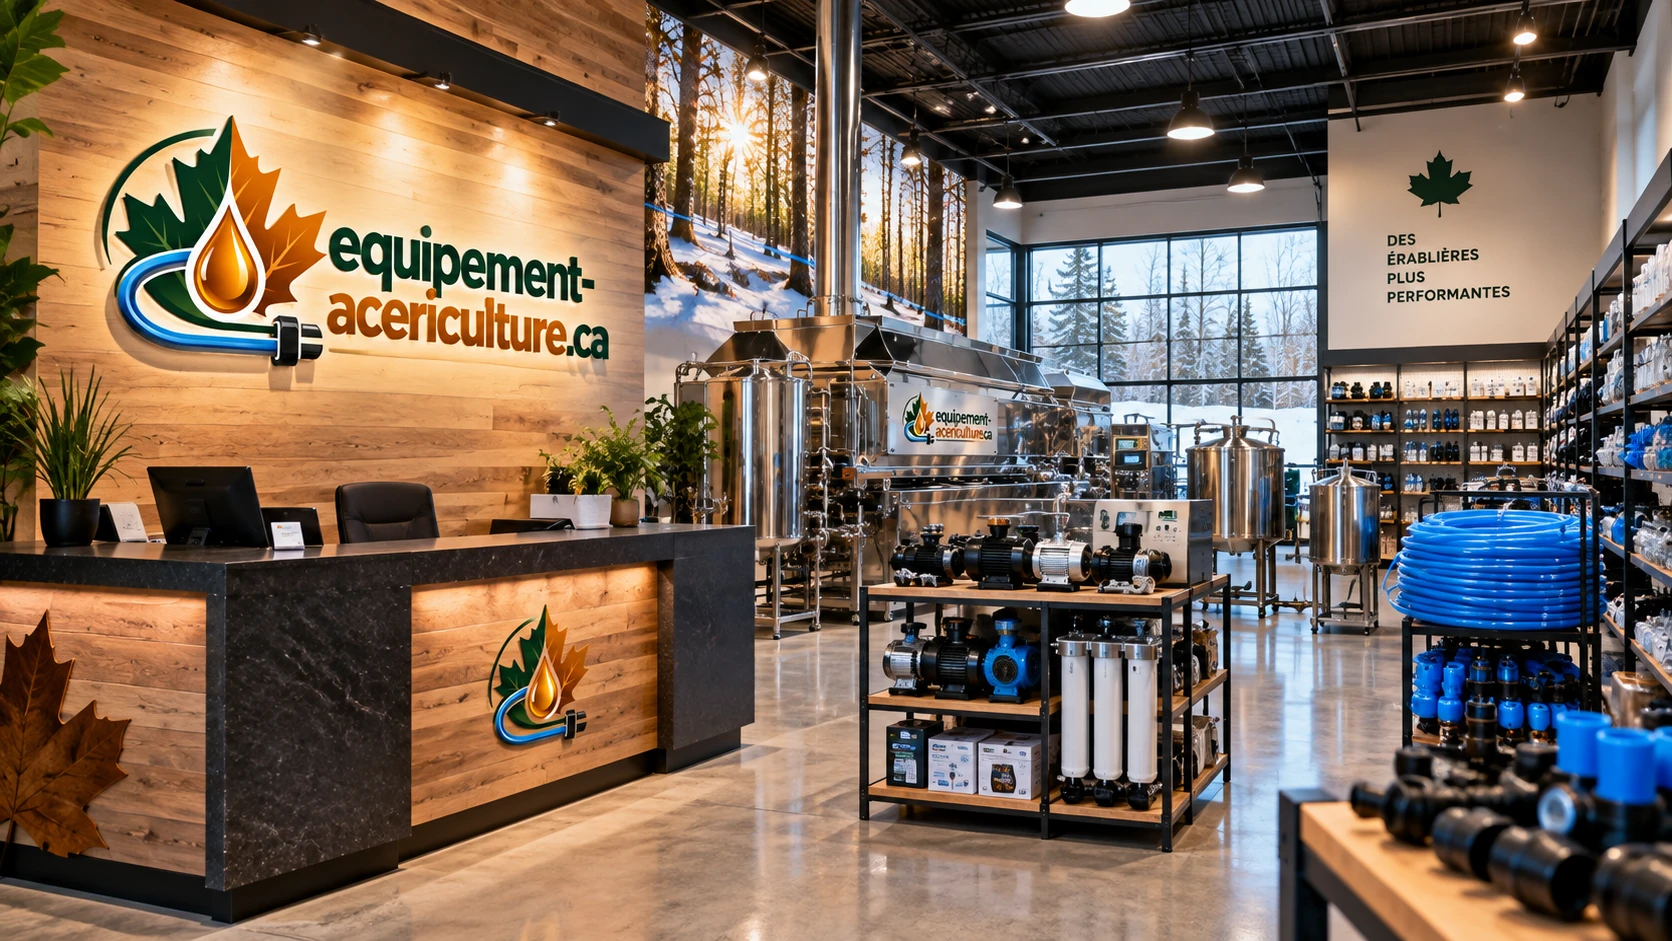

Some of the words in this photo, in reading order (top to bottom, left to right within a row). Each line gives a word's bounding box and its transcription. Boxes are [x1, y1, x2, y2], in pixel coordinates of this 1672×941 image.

[1387, 233, 1416, 247] DES
[329, 225, 595, 303] equipement-
[1387, 247, 1479, 266] ÉRABLIÈRES
[1387, 271, 1425, 284] PLUS
[1387, 285, 1511, 303] PERFORMANTES
[326, 287, 609, 360] acericulture.ca
[935, 409, 991, 427] equipement-
[935, 426, 992, 440] acericultureca
